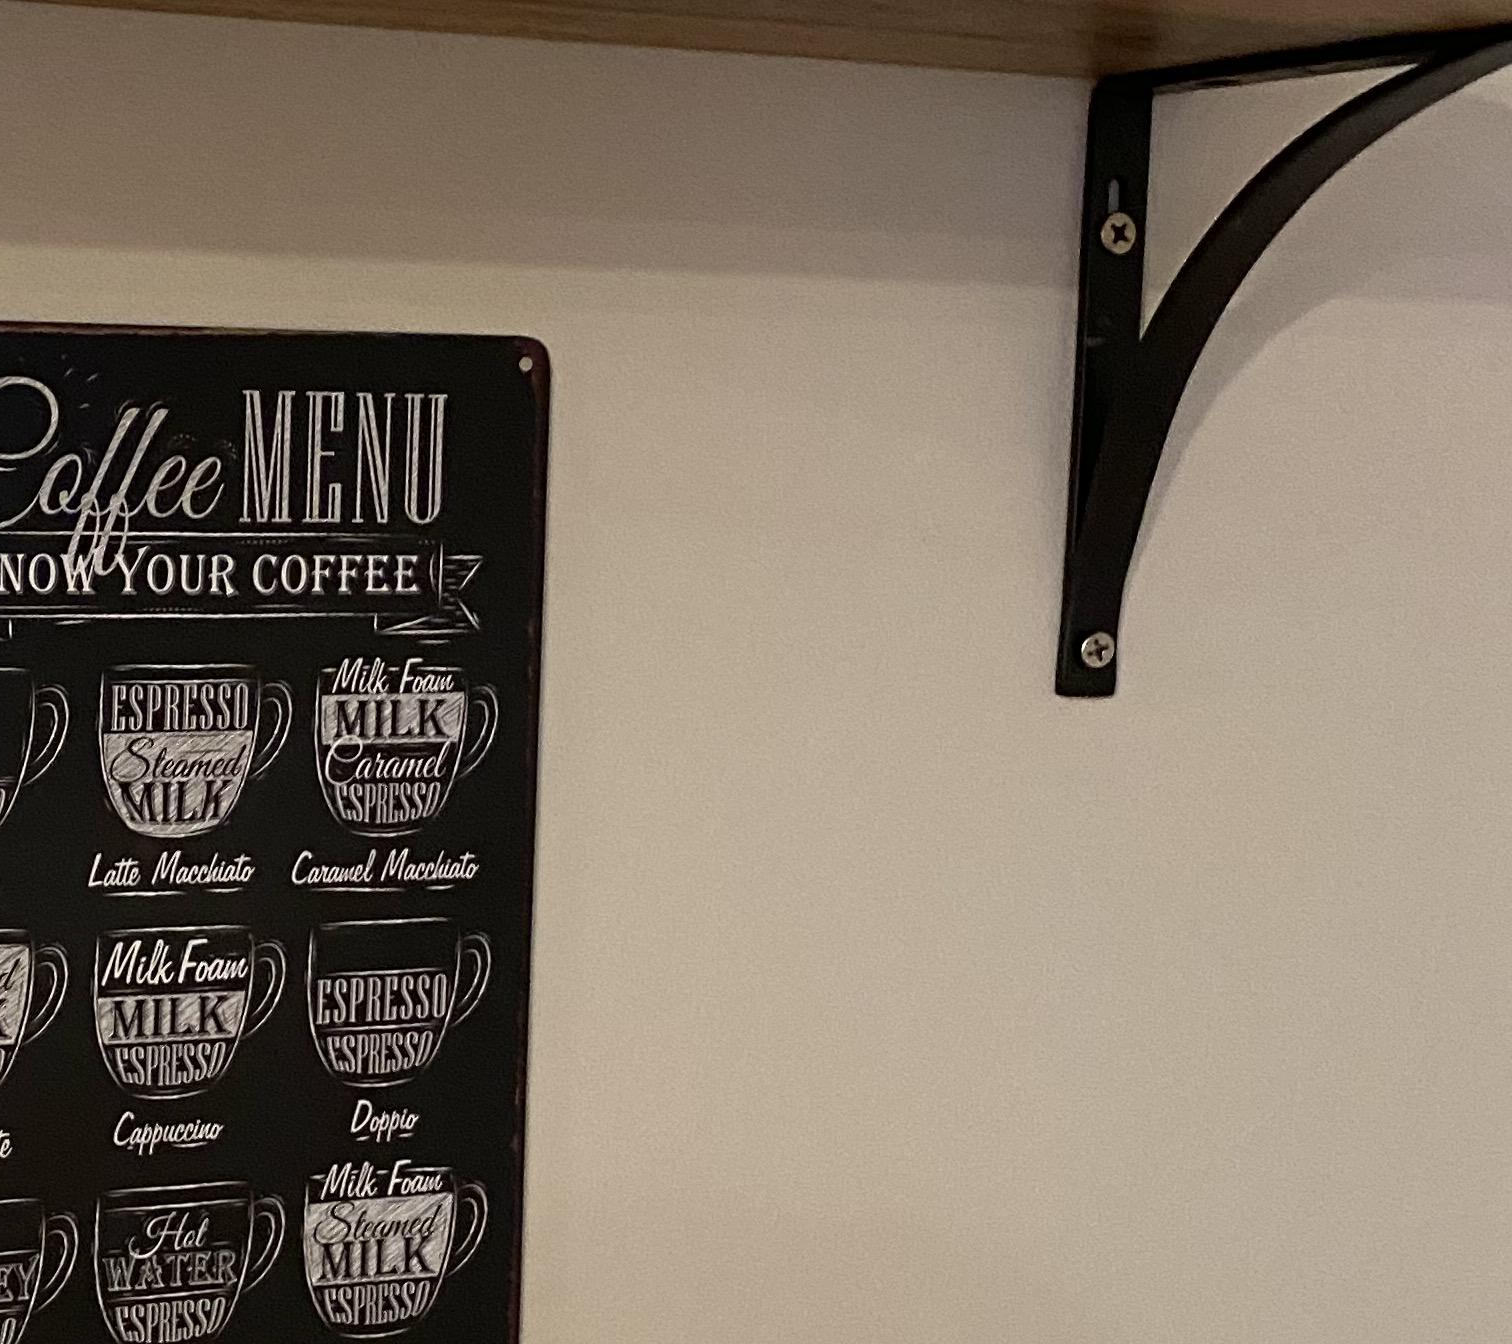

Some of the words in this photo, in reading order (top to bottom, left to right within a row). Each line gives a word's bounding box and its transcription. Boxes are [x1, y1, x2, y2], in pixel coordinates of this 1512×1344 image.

[238, 390, 448, 524] MENU
[116, 546, 238, 597] YOUR
[252, 553, 421, 595] COFFEE
[333, 658, 389, 694] Milk
[399, 658, 454, 692] Foam
[111, 683, 249, 732] ESPRESSO
[335, 698, 447, 738] MILK
[110, 736, 243, 781] Steamed
[325, 734, 448, 784] Caramel
[117, 779, 236, 825] MILK
[333, 781, 441, 825] ESPRESSO
[88, 851, 141, 888] Latte
[152, 850, 255, 886] Macchiato
[292, 850, 373, 885] Caramel
[382, 848, 480, 882] Macchiato
[102, 940, 175, 986] Milk
[179, 939, 248, 983] Foam
[105, 993, 229, 1041] MILK
[316, 973, 447, 1025] ESPRESSO
[114, 1040, 227, 1087] ESPRESSO
[326, 1028, 432, 1075] ESPRESSO
[114, 1111, 223, 1153] Cappuccino
[351, 1100, 419, 1141] Doppio
[321, 1161, 378, 1200] Milk
[387, 1159, 443, 1196] Foam
[130, 1210, 208, 1259] Hot
[313, 1202, 441, 1244] Steamed
[102, 1251, 238, 1293] WATER
[317, 1236, 436, 1282] MILK
[114, 1296, 226, 1344] ESPRESSO
[323, 1280, 431, 1326] ESPRESSO
